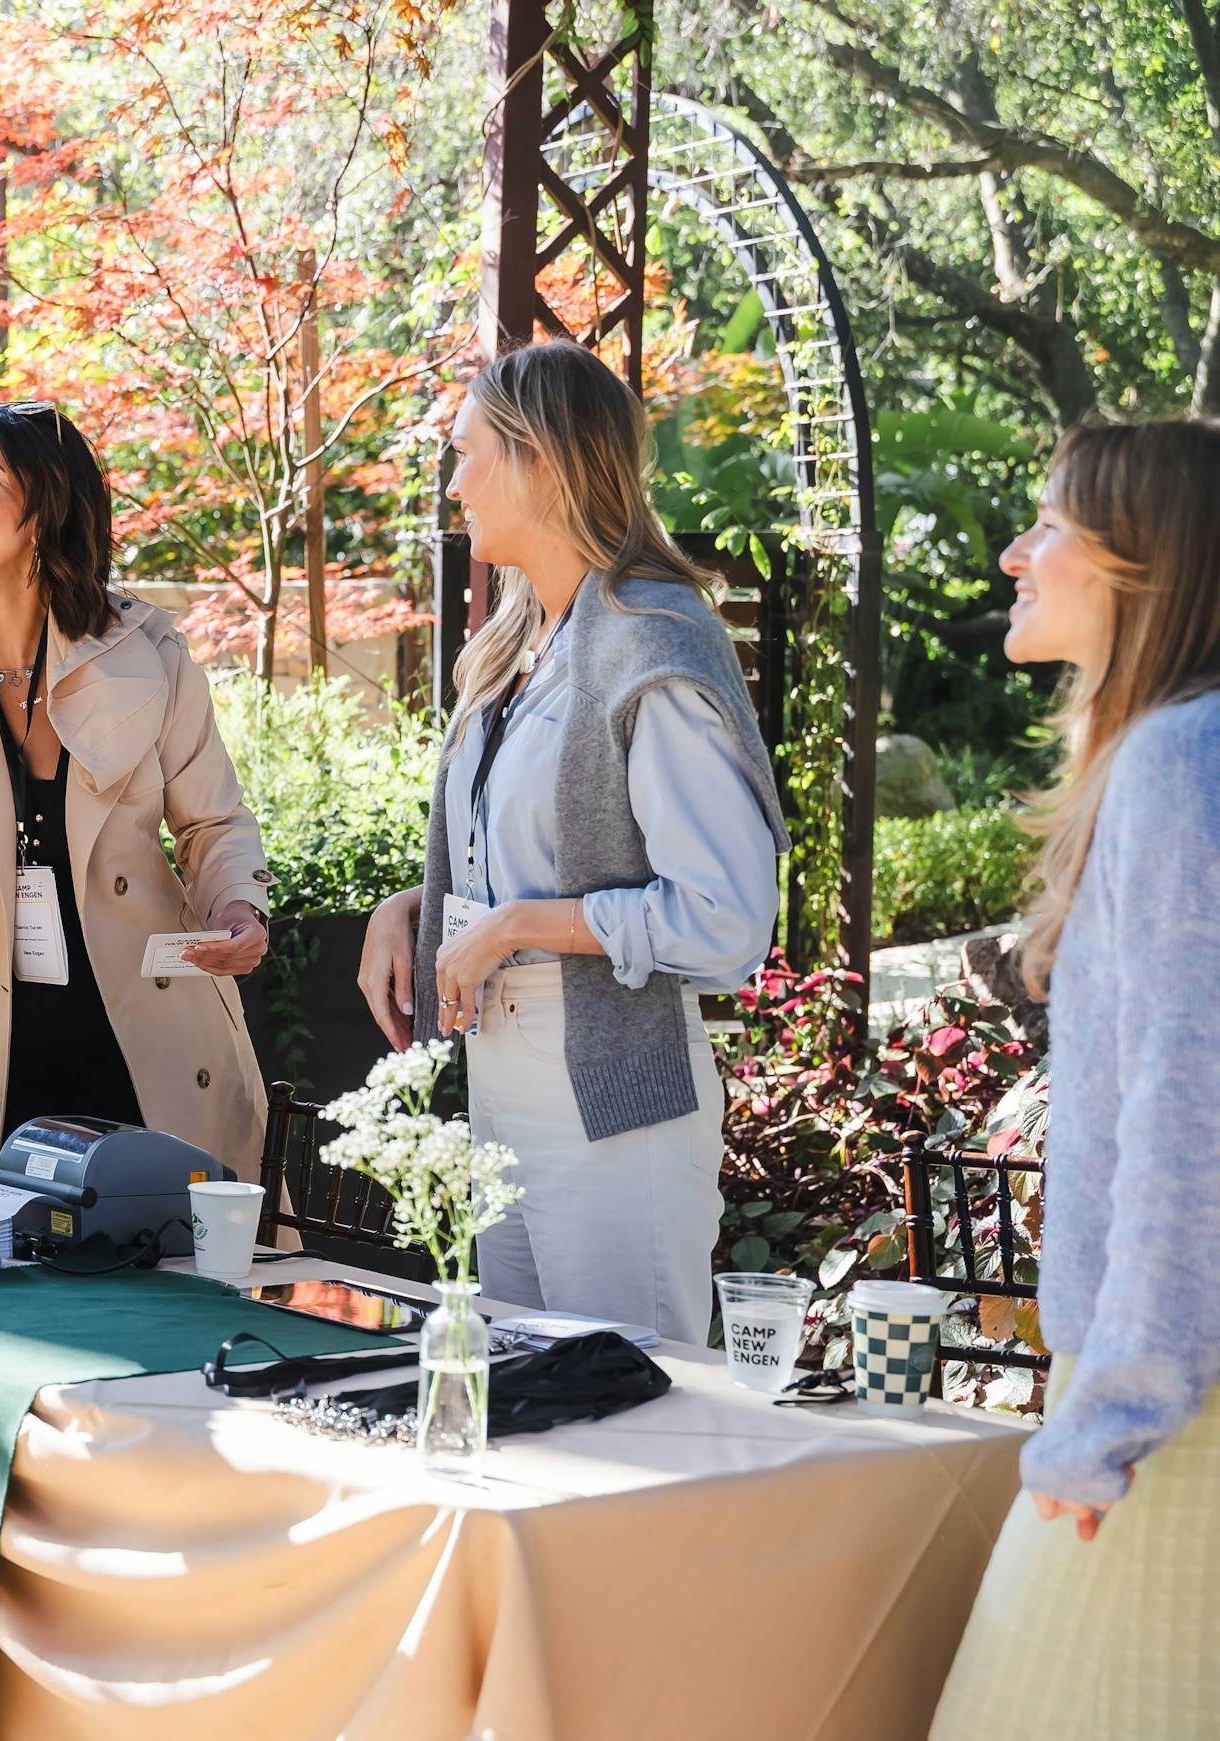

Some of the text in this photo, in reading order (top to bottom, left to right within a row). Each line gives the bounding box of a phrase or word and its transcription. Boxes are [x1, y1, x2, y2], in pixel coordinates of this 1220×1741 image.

[448, 915, 468, 929] CAMP
[447, 927, 458, 938] NE
[731, 1323, 776, 1339] CAMP
[732, 1336, 766, 1352] NEW
[733, 1350, 780, 1367] ENGEN
